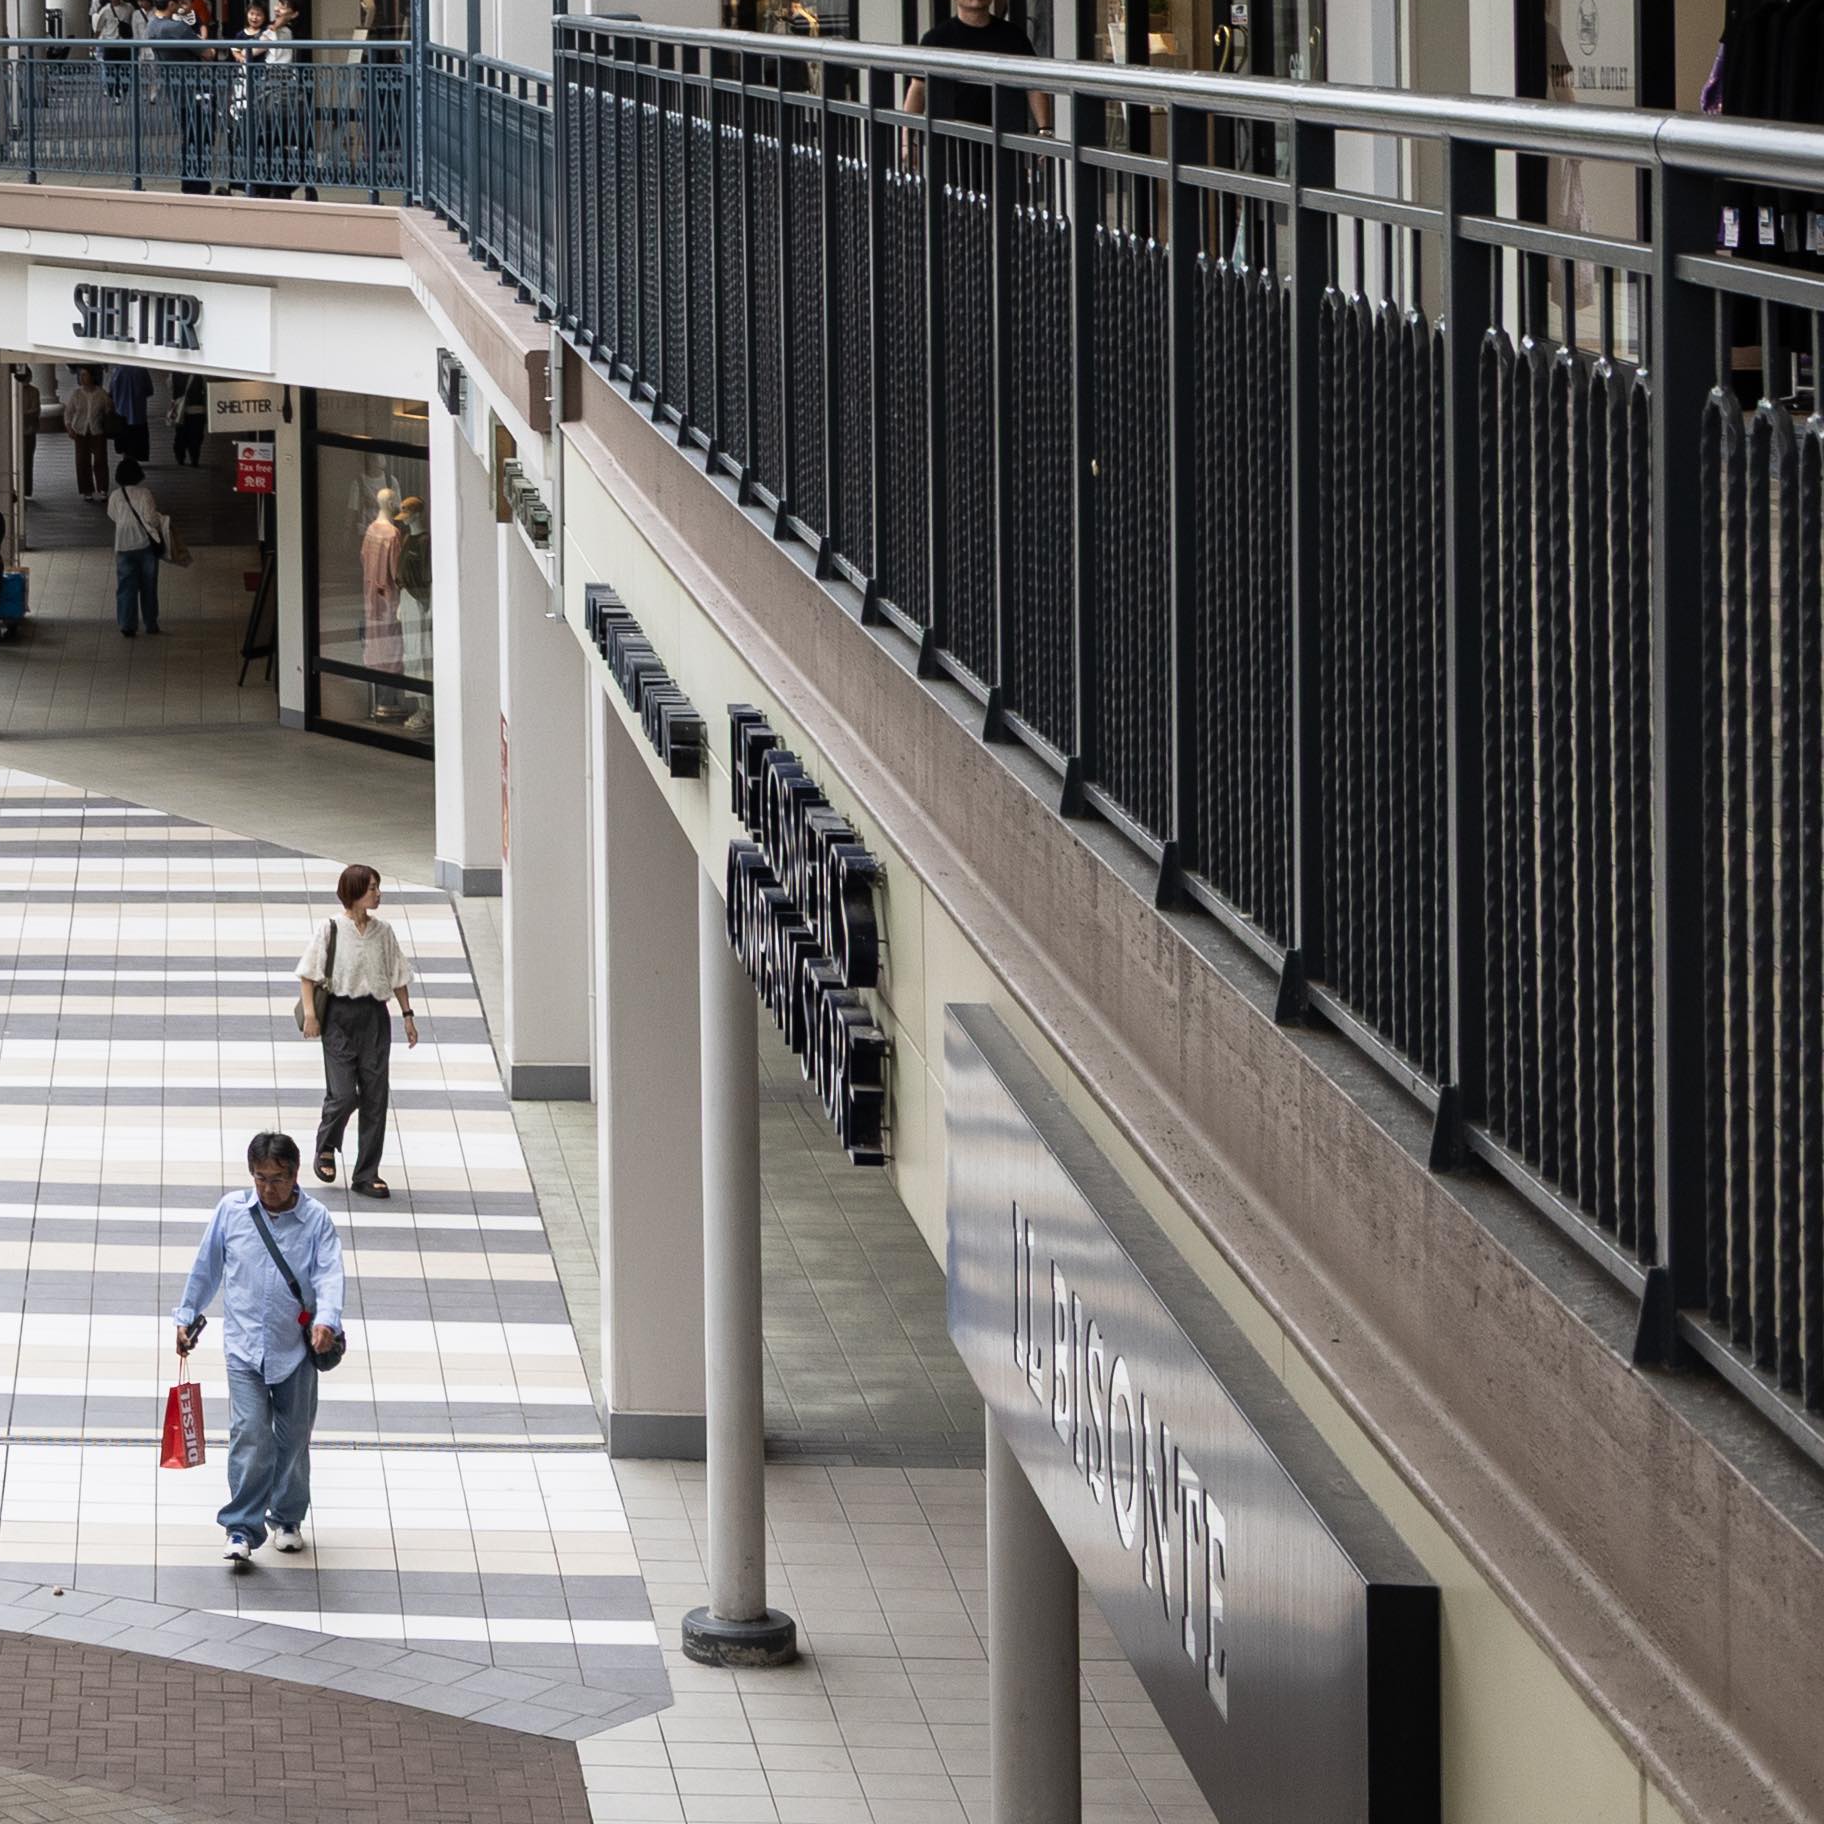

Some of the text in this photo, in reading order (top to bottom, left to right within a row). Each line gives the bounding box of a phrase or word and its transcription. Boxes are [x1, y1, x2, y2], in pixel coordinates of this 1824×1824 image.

[239, 461, 273, 473] Tax free
[243, 476, 266, 488] 免税
[179, 1387, 199, 1463] DIESEL
[1013, 1200, 1229, 1724] IL BISONTE
